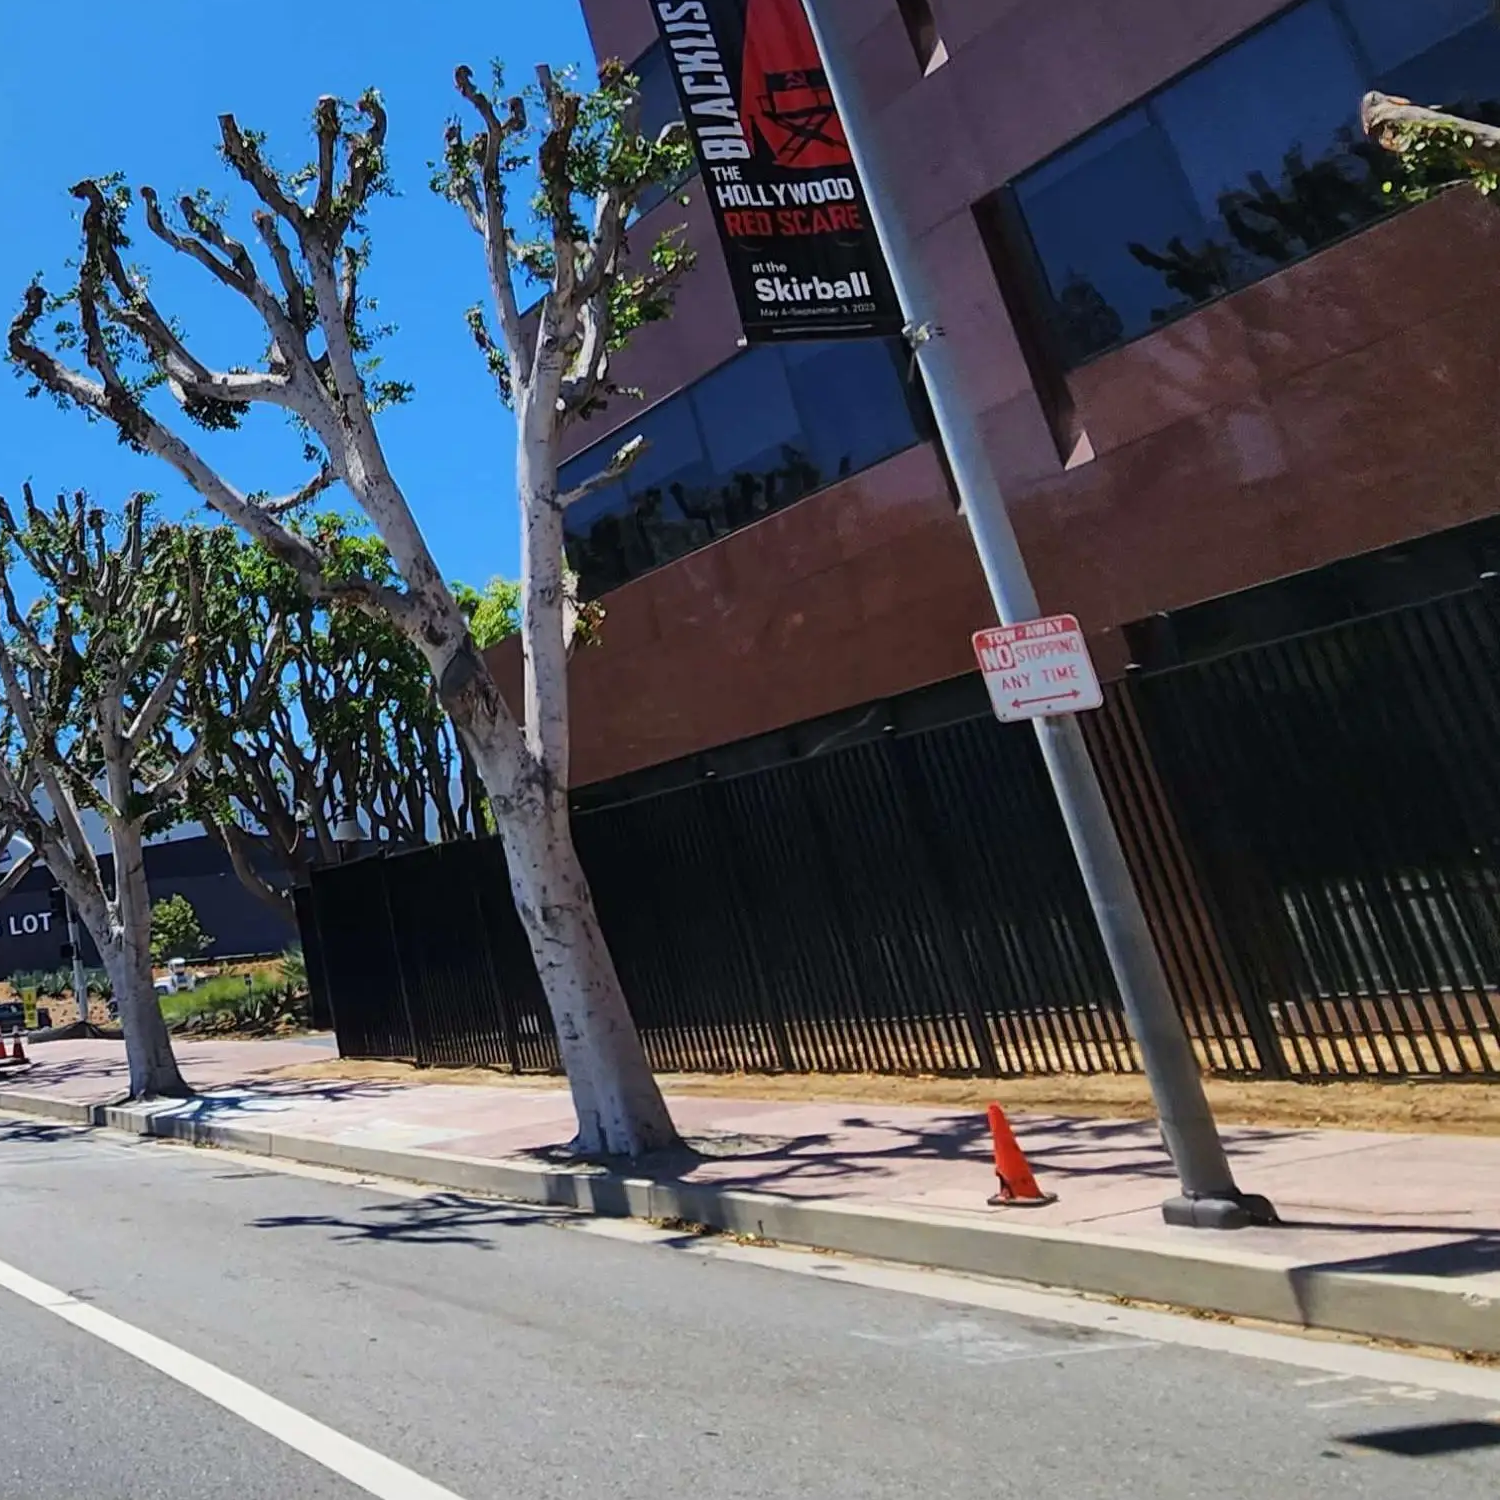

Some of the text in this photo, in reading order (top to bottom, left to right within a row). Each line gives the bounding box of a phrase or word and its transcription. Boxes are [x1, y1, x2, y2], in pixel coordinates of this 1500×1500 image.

[710, 165, 743, 182] THE
[715, 178, 856, 208] HOLLYWOOD
[724, 204, 865, 237] RED SCARE
[751, 260, 788, 274] at the
[755, 271, 871, 302] Skirball
[760, 307, 779, 318] May
[852, 301, 876, 314] 2023
[980, 635, 1080, 672] NO STOPPING
[1002, 663, 1080, 690] ANY TIME
[9, 912, 52, 936] LOT
